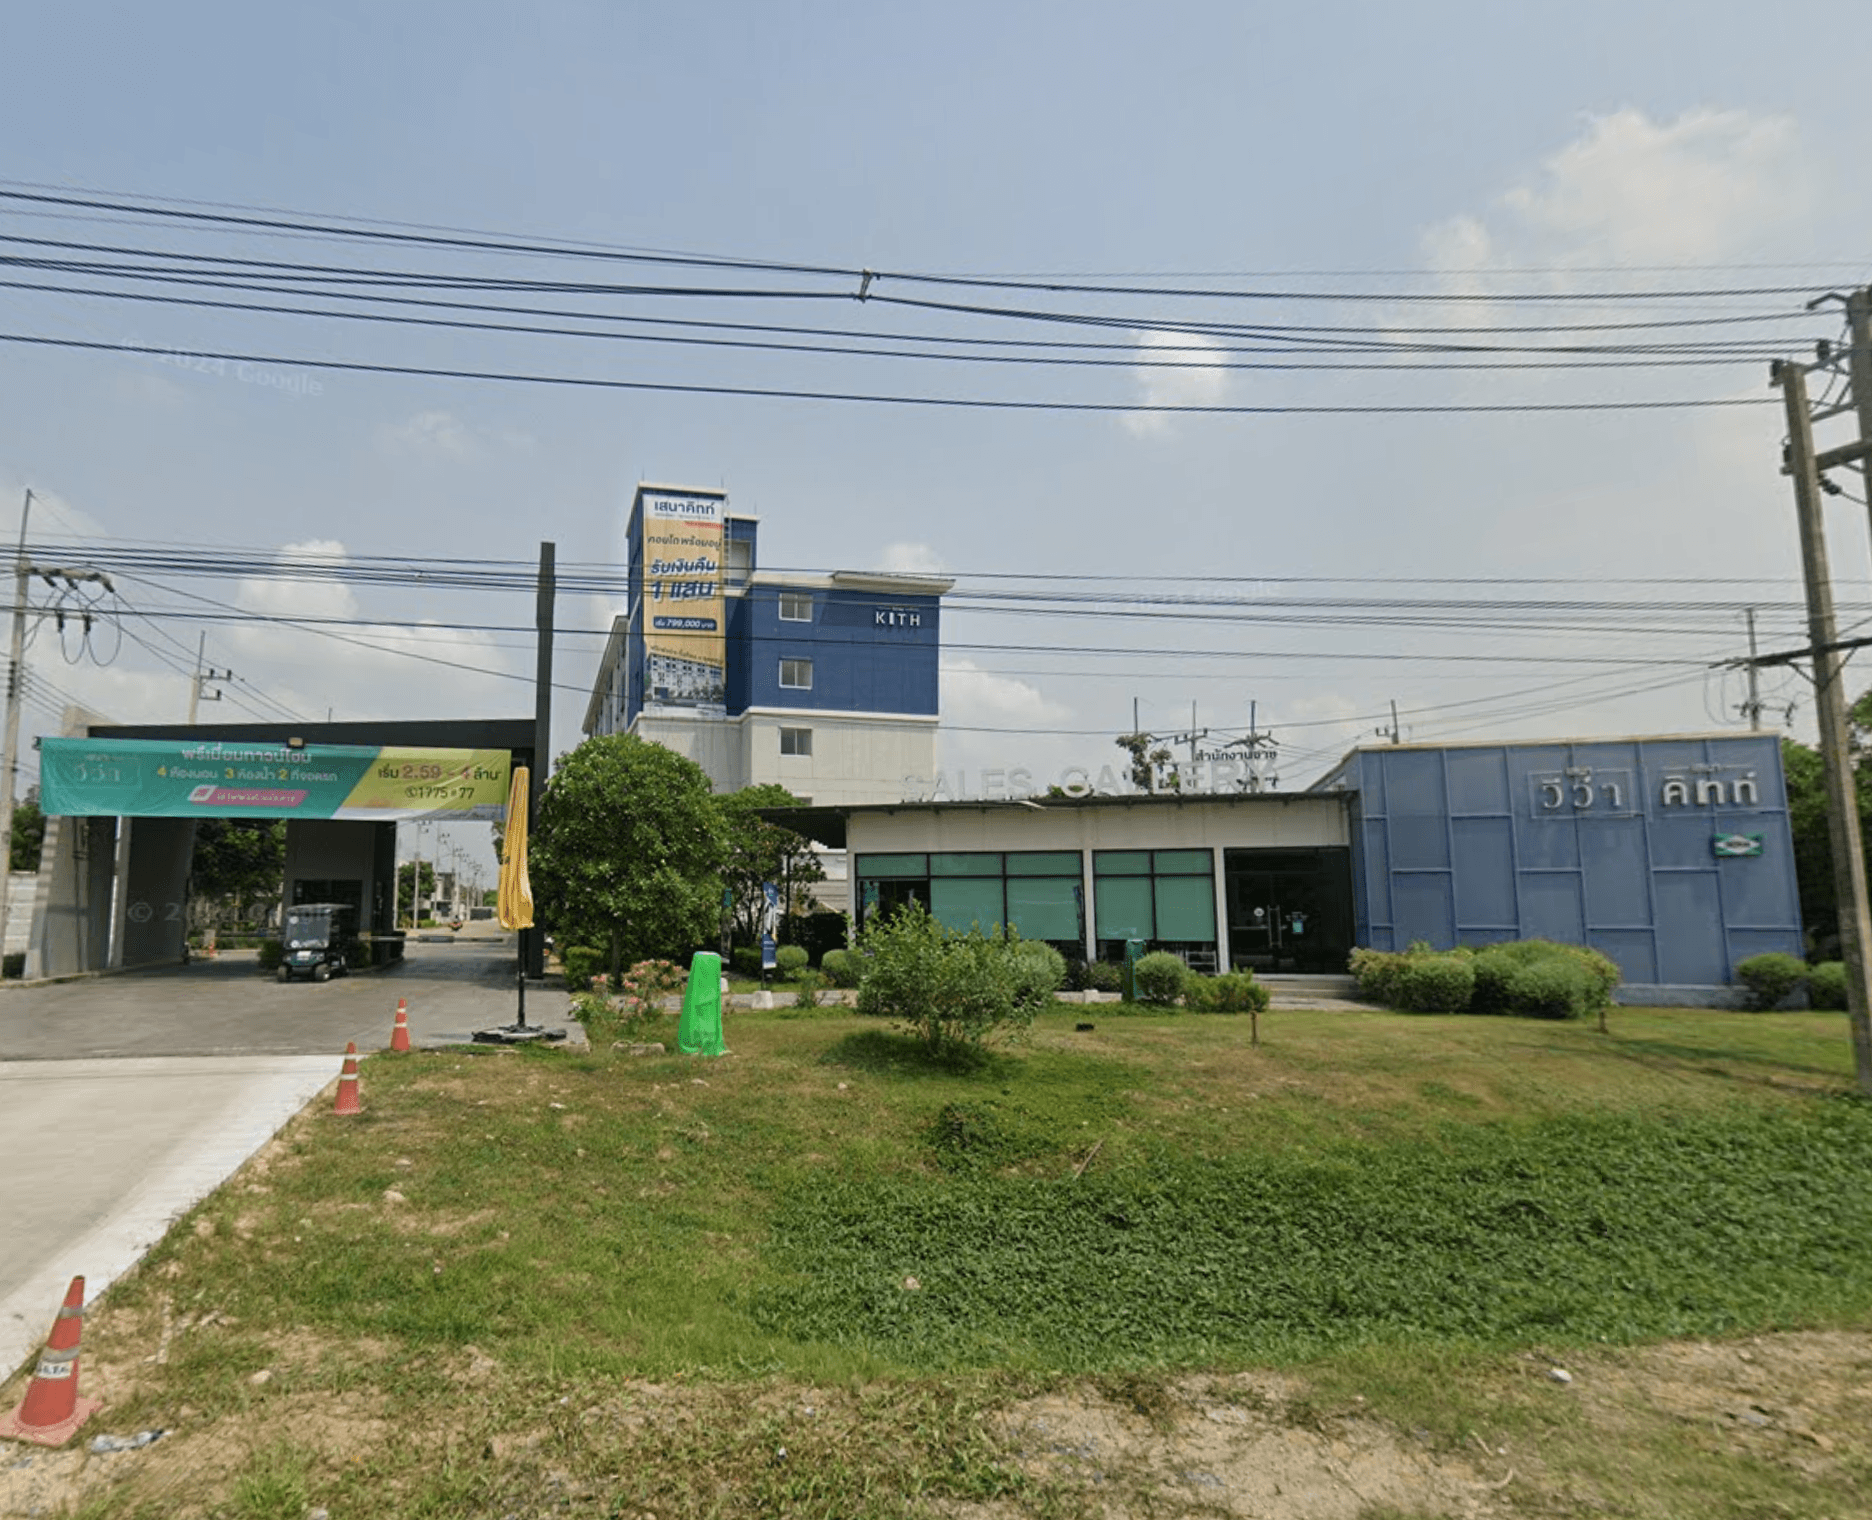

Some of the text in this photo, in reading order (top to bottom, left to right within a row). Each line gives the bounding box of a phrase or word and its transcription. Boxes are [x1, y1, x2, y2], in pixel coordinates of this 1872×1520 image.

[651, 557, 715, 574] รับเงินคืน
[670, 580, 713, 597] แสน
[875, 611, 921, 627] KITH
[1195, 747, 1278, 762] สำนักงานขาย
[157, 765, 168, 778] 4
[225, 767, 234, 779] 3
[278, 768, 289, 781] 2
[378, 763, 399, 779] เริ่ม
[402, 764, 442, 780] 2.59
[902, 759, 1280, 802] SALES GALLERY
